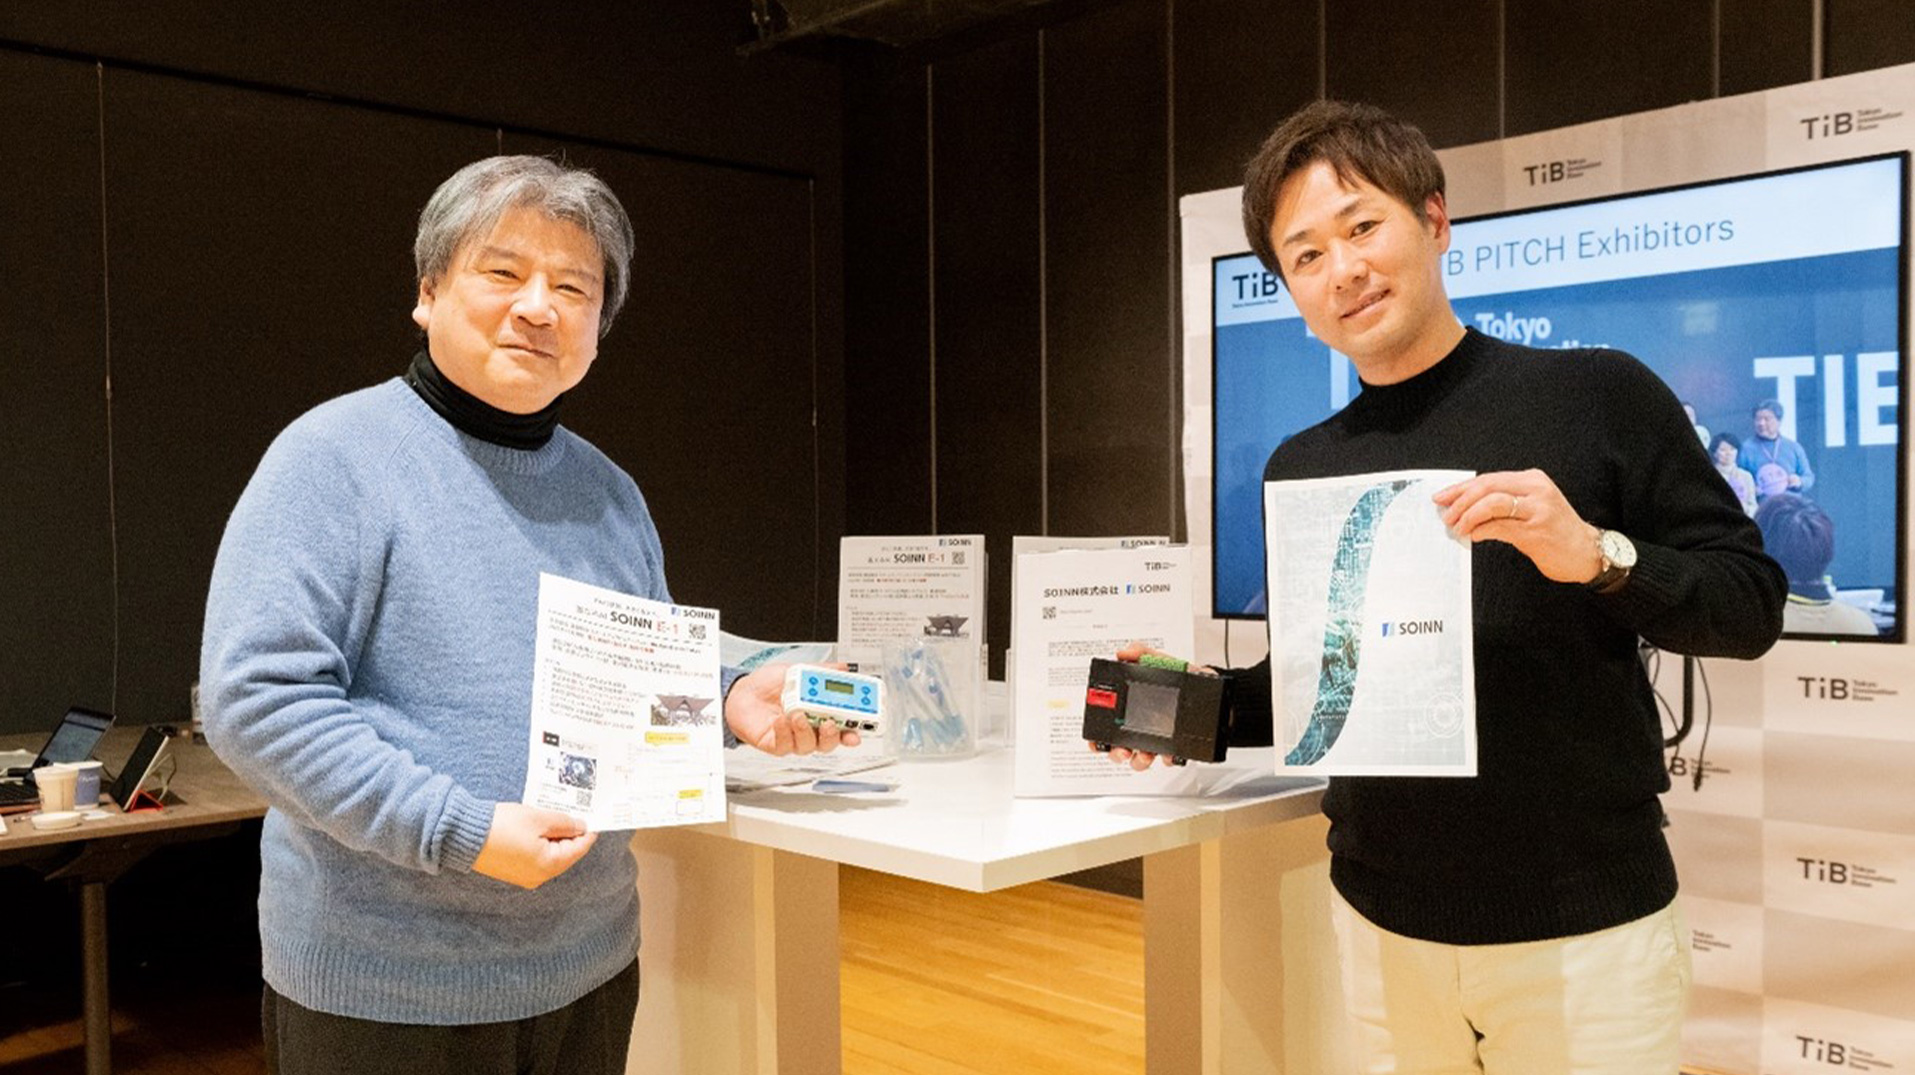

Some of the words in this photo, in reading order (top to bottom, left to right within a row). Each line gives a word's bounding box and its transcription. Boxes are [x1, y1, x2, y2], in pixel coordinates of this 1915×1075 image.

[1800, 112, 1853, 139] TiB
[1523, 161, 1565, 186] TiB
[1475, 236, 1566, 272] PITCH
[1578, 219, 1735, 259] Exhibitors
[1232, 271, 1280, 300] TiB
[1475, 312, 1552, 344] Tokyo
[893, 553, 926, 564] SOINN
[1138, 584, 1171, 593] SOINN
[610, 610, 652, 631] SOINN
[683, 609, 716, 620] SOINN
[1399, 620, 1443, 635] SOINN
[1797, 676, 1849, 701] TiB
[1797, 857, 1847, 885] TiB
[1796, 1035, 1846, 1066] TiB
